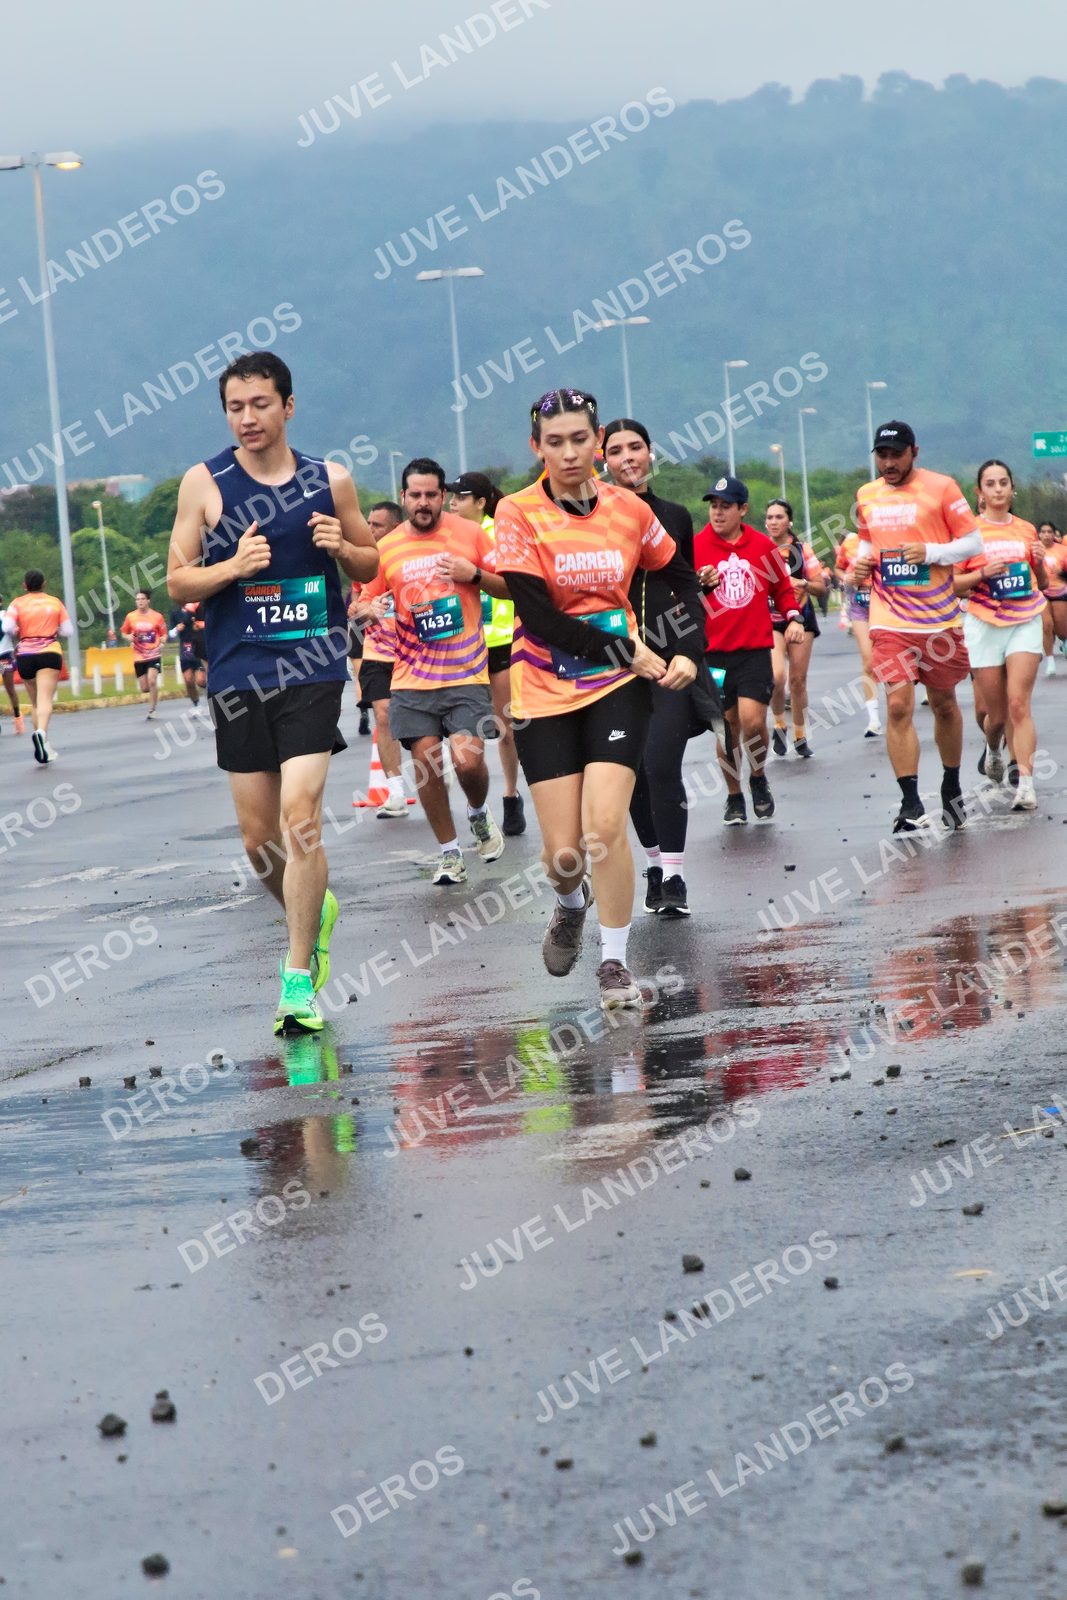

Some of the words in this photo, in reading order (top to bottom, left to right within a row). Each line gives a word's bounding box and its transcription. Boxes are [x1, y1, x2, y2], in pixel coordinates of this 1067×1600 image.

[555, 550, 625, 573] CARRERA
[887, 564, 918, 576] 1080
[556, 571, 614, 587] OMNILIFE
[997, 575, 1025, 590] 1673
[244, 585, 282, 596] CARRERA
[304, 581, 320, 594] 10K
[257, 603, 308, 623] 1248
[609, 614, 622, 627] 10K
[421, 613, 453, 631] 1432
